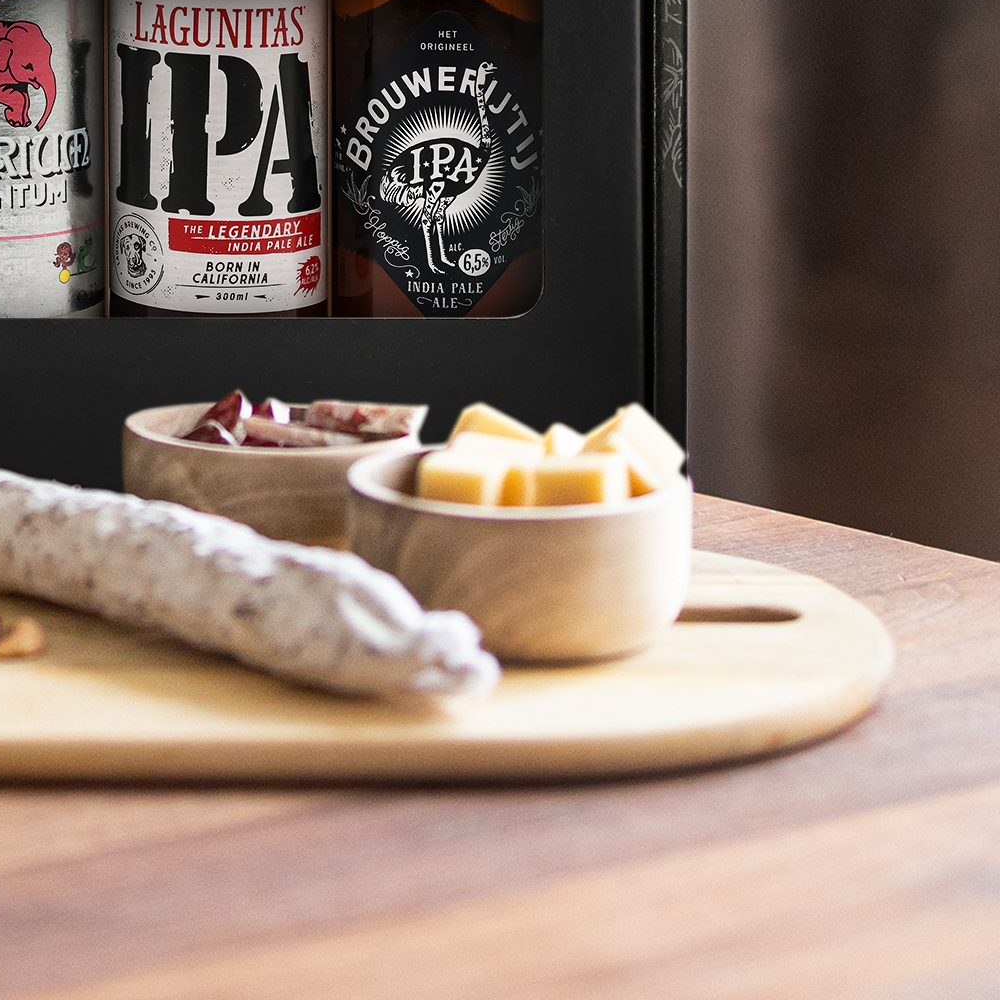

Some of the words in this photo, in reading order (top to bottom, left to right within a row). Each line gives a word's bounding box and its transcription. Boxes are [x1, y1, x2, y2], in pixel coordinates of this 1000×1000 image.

[134, 1, 305, 49] LAGUNITAS
[438, 30, 457, 39] HET
[420, 42, 475, 51] ORIGINEEL
[116, 43, 322, 217] IPA
[124, 221, 150, 239] BREWING
[184, 225, 204, 234] THE
[208, 220, 302, 239] LEGENDARY
[227, 242, 261, 252] INDIA
[266, 239, 292, 250] PALE
[296, 234, 314, 248] ALE
[448, 243, 465, 252] ALC.
[206, 261, 243, 272] BORN
[247, 261, 261, 272] IN
[463, 253, 489, 273] 6,5%
[493, 255, 507, 265] VOL.
[125, 280, 142, 290] SINCE
[143, 269, 157, 286] 1993
[192, 272, 268, 285] CALIFORNIA
[407, 281, 445, 294] INDIA
[451, 282, 483, 294] PALE
[215, 292, 249, 301] 300ml
[432, 297, 458, 309] ALE
